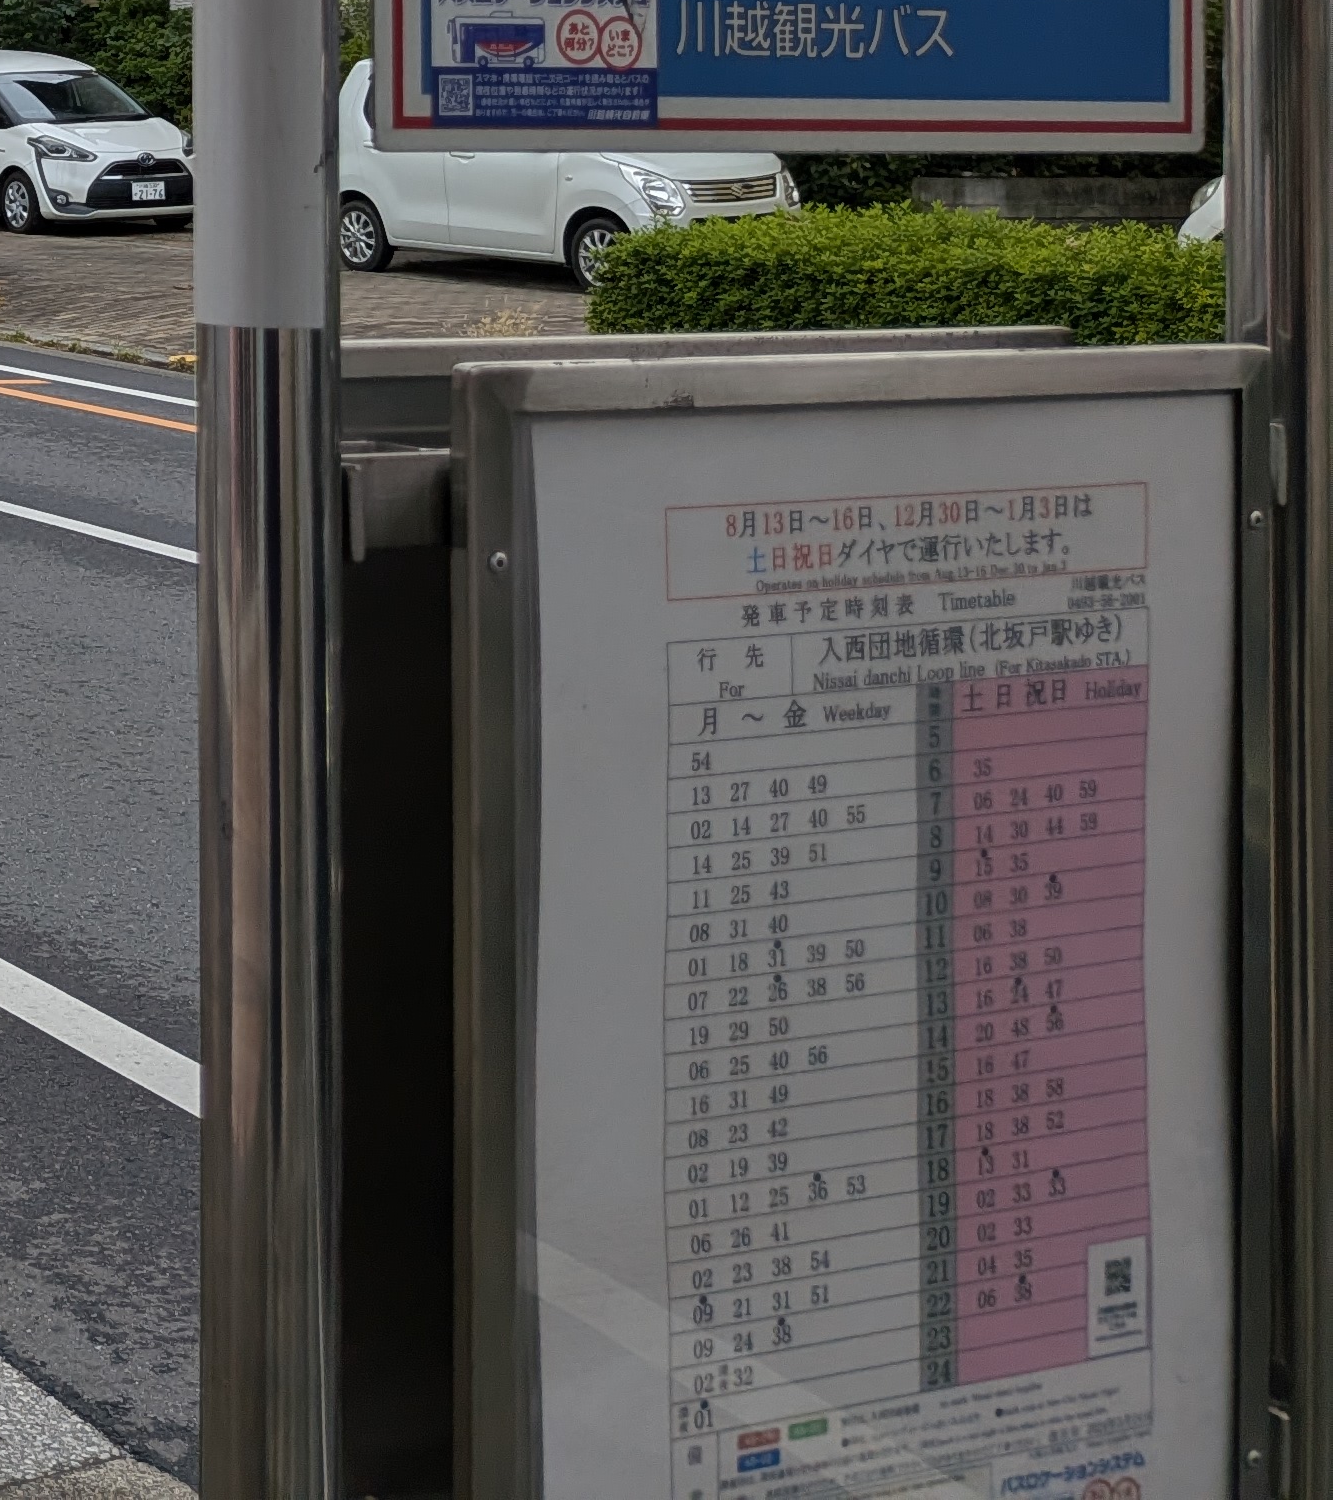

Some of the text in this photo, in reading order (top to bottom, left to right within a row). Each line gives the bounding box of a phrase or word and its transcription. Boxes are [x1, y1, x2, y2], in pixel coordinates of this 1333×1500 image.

[568, 22, 591, 36] あと
[608, 28, 631, 43] いま
[746, 527, 1072, 574] 土日祝日ダイヤで運行いたします。
[740, 596, 914, 629] 発車予定時刻表
[938, 588, 1016, 612] Timetable
[696, 643, 765, 672] 行先
[818, 613, 1124, 665] 入西団地循環(北坂戸駅ゆき)
[719, 682, 745, 698] For
[813, 670, 859, 690] Nissai
[863, 666, 912, 688] danchi
[917, 664, 956, 686] Loop
[959, 660, 986, 680] line
[996, 658, 1023, 676] (For
[823, 701, 892, 724] Weekday
[692, 725, 941, 771] 54 5
[693, 759, 941, 806] 13 27 40 49 6
[691, 792, 941, 840] 02 14 27 40 55 7
[693, 825, 942, 875] 14 25 39 51 8
[693, 859, 941, 909] 11 25 43 9
[690, 890, 948, 942] 08 31 40 10
[688, 958, 707, 977] 01
[731, 953, 748, 972] 18
[807, 944, 826, 963] 39
[845, 939, 865, 959] 50
[925, 924, 945, 950] 11
[688, 991, 708, 1011] 07
[729, 987, 748, 1006] 22
[808, 978, 826, 997] 38
[846, 973, 865, 992] 56
[925, 958, 949, 983] 12
[690, 991, 948, 1046] 19 29 50 13
[689, 1024, 948, 1080] 06 25 40 56 14
[691, 1057, 949, 1116] 16 31 49 15
[689, 1091, 949, 1149] 08 23 42 16
